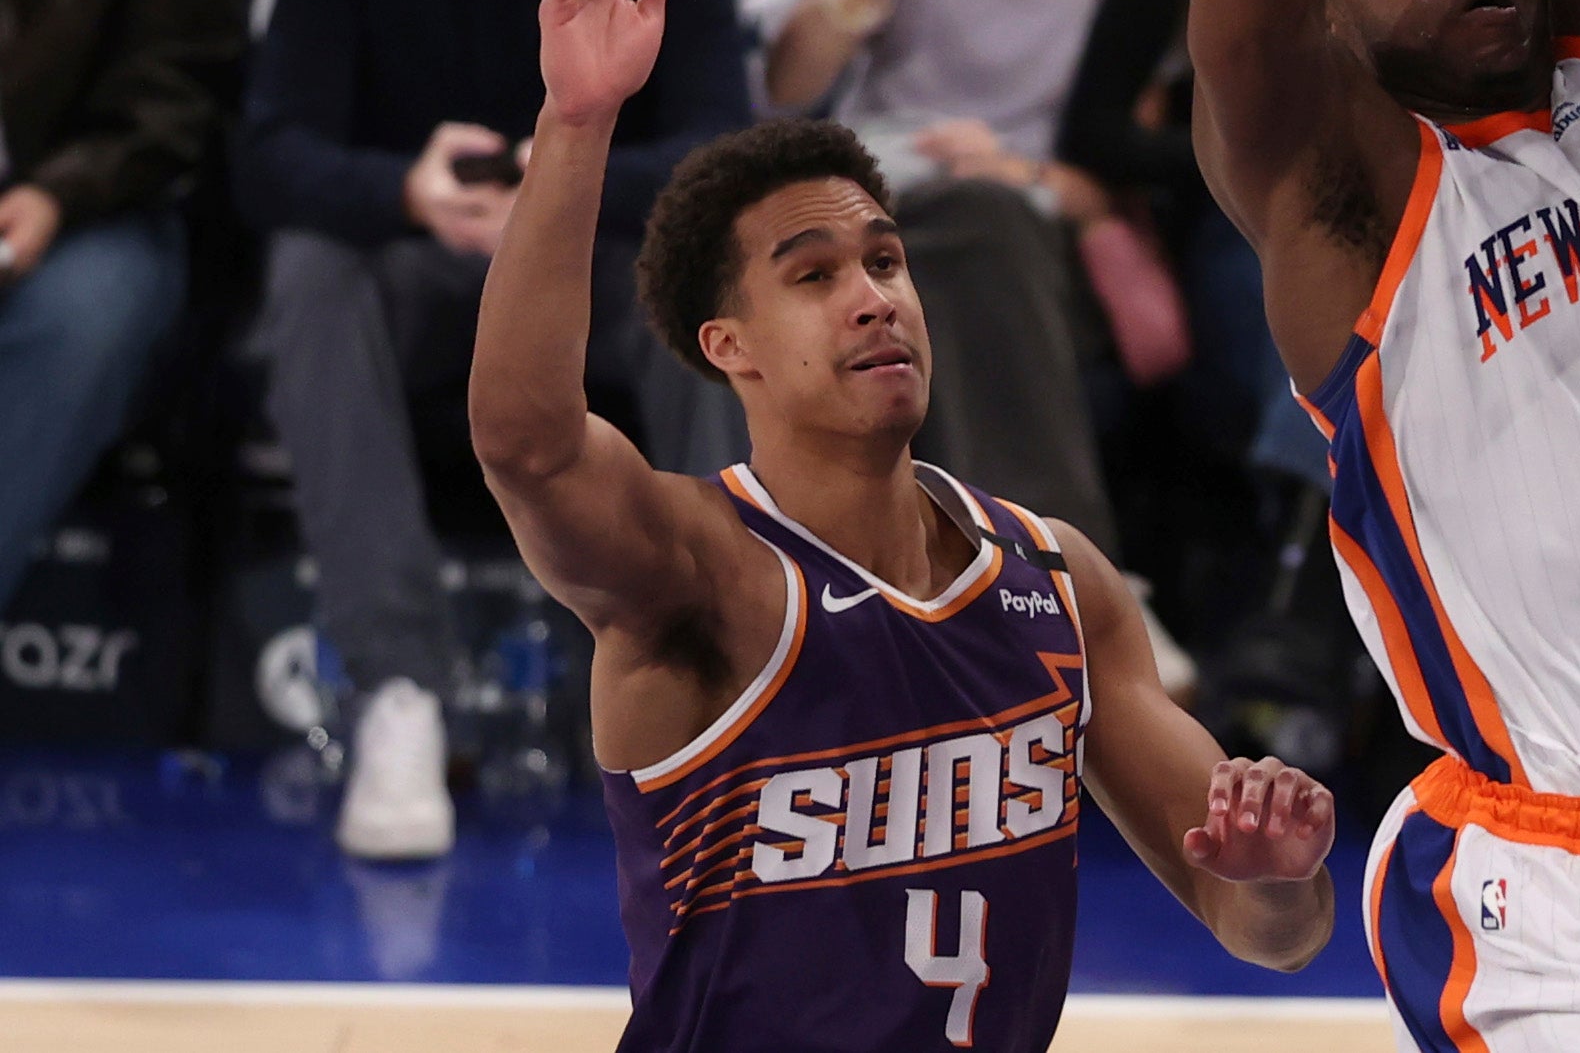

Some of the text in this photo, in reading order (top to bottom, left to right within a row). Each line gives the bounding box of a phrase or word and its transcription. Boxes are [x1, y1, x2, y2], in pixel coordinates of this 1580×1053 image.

[999, 588, 1061, 620] PayPal
[0, 623, 138, 689] azr
[904, 888, 991, 1048] 4
